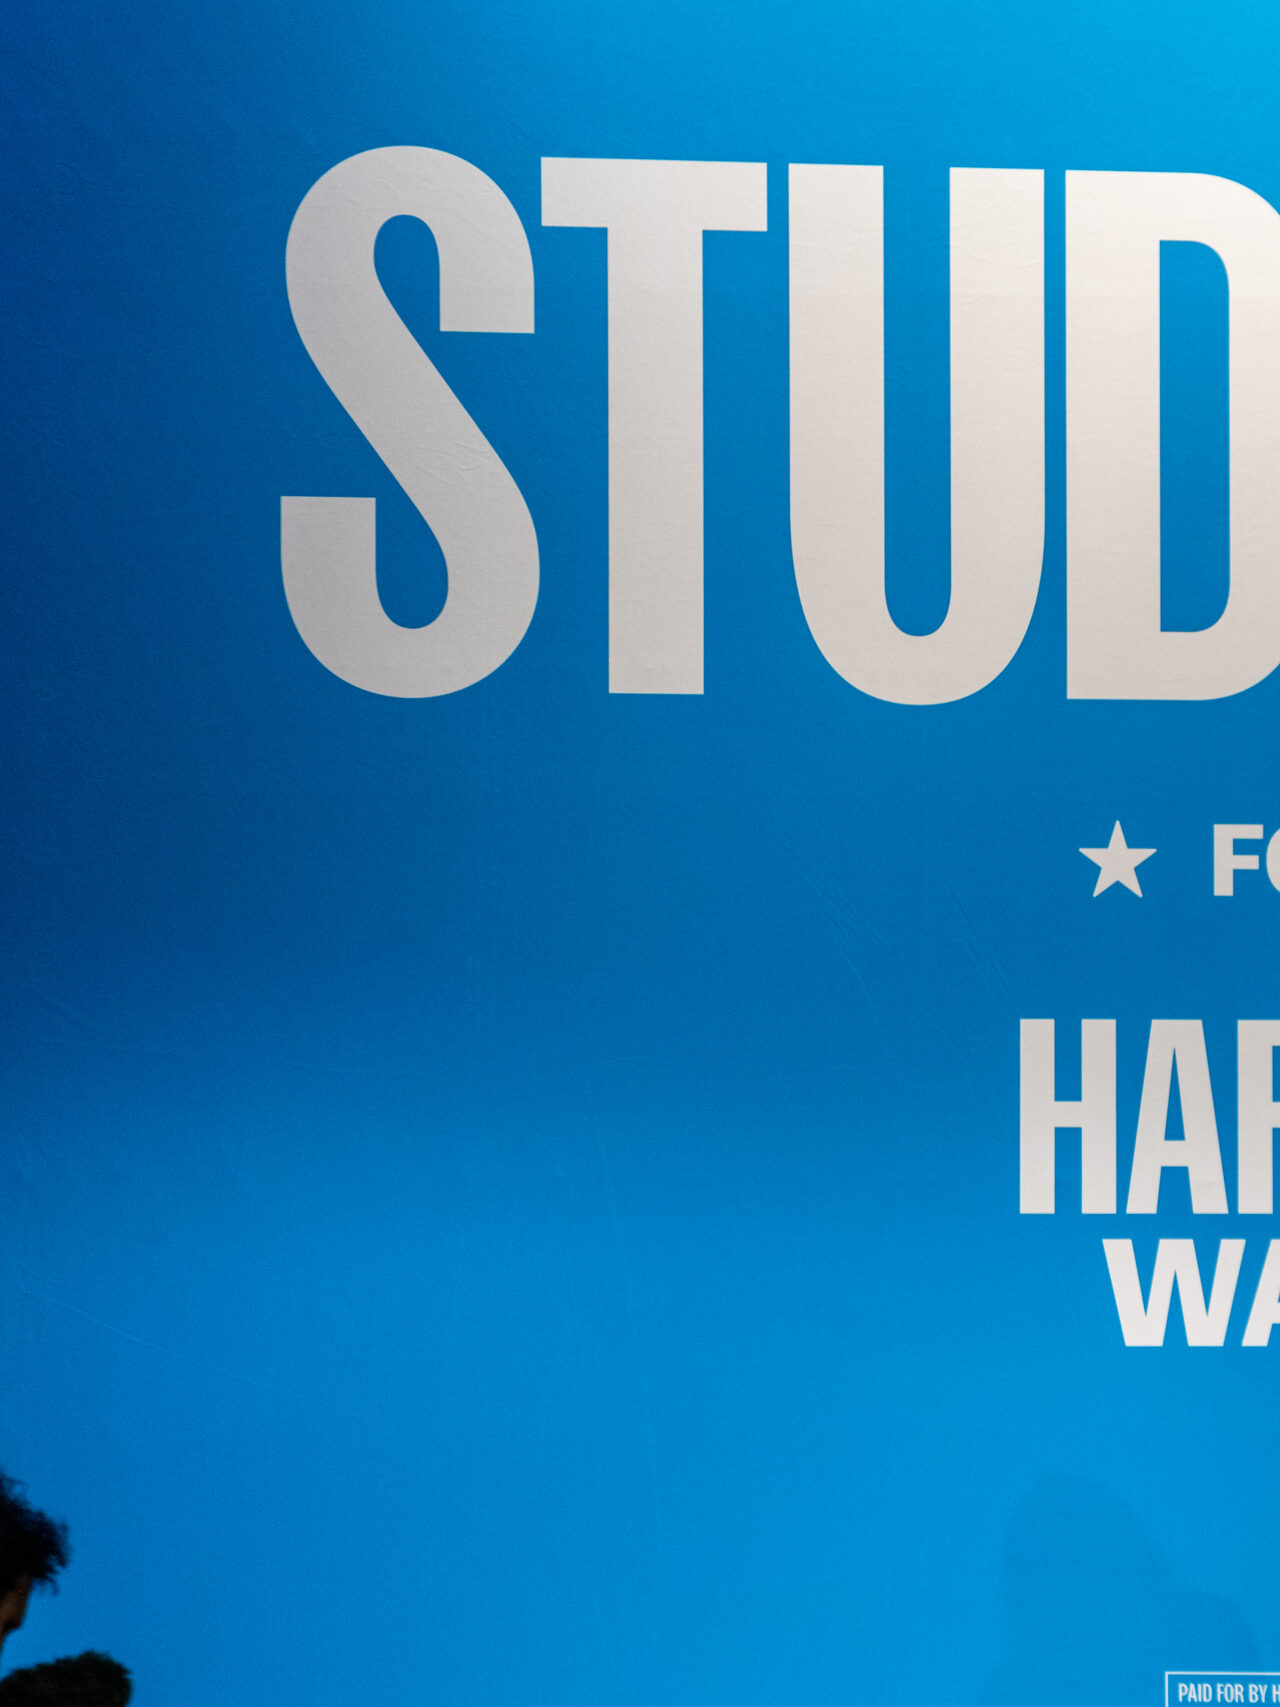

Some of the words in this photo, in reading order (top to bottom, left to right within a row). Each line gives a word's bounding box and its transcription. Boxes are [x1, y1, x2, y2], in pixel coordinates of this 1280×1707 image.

[1178, 1683, 1213, 1703] PAID
[1216, 1683, 1245, 1703] FOR
[1248, 1683, 1268, 1703] BY
